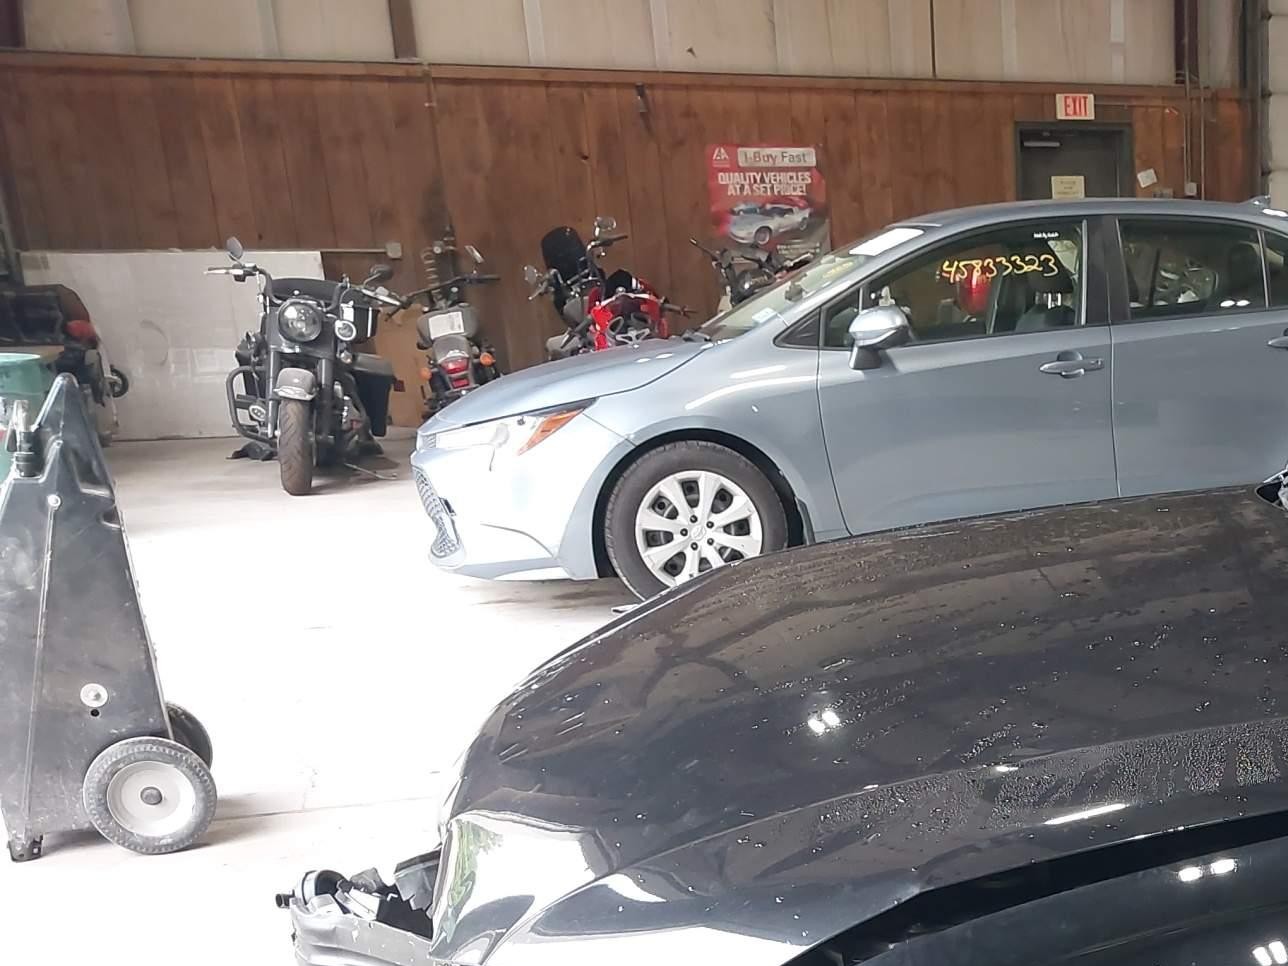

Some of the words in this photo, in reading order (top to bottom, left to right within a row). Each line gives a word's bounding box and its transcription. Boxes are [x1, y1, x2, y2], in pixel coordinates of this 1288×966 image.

[1063, 95, 1089, 117] EXIT
[781, 150, 808, 163] Fast
[717, 171, 762, 185] QUALITY
[762, 171, 812, 184] VEHICLES
[727, 183, 742, 196] AT
[743, 183, 752, 196] A
[753, 183, 772, 196] SET
